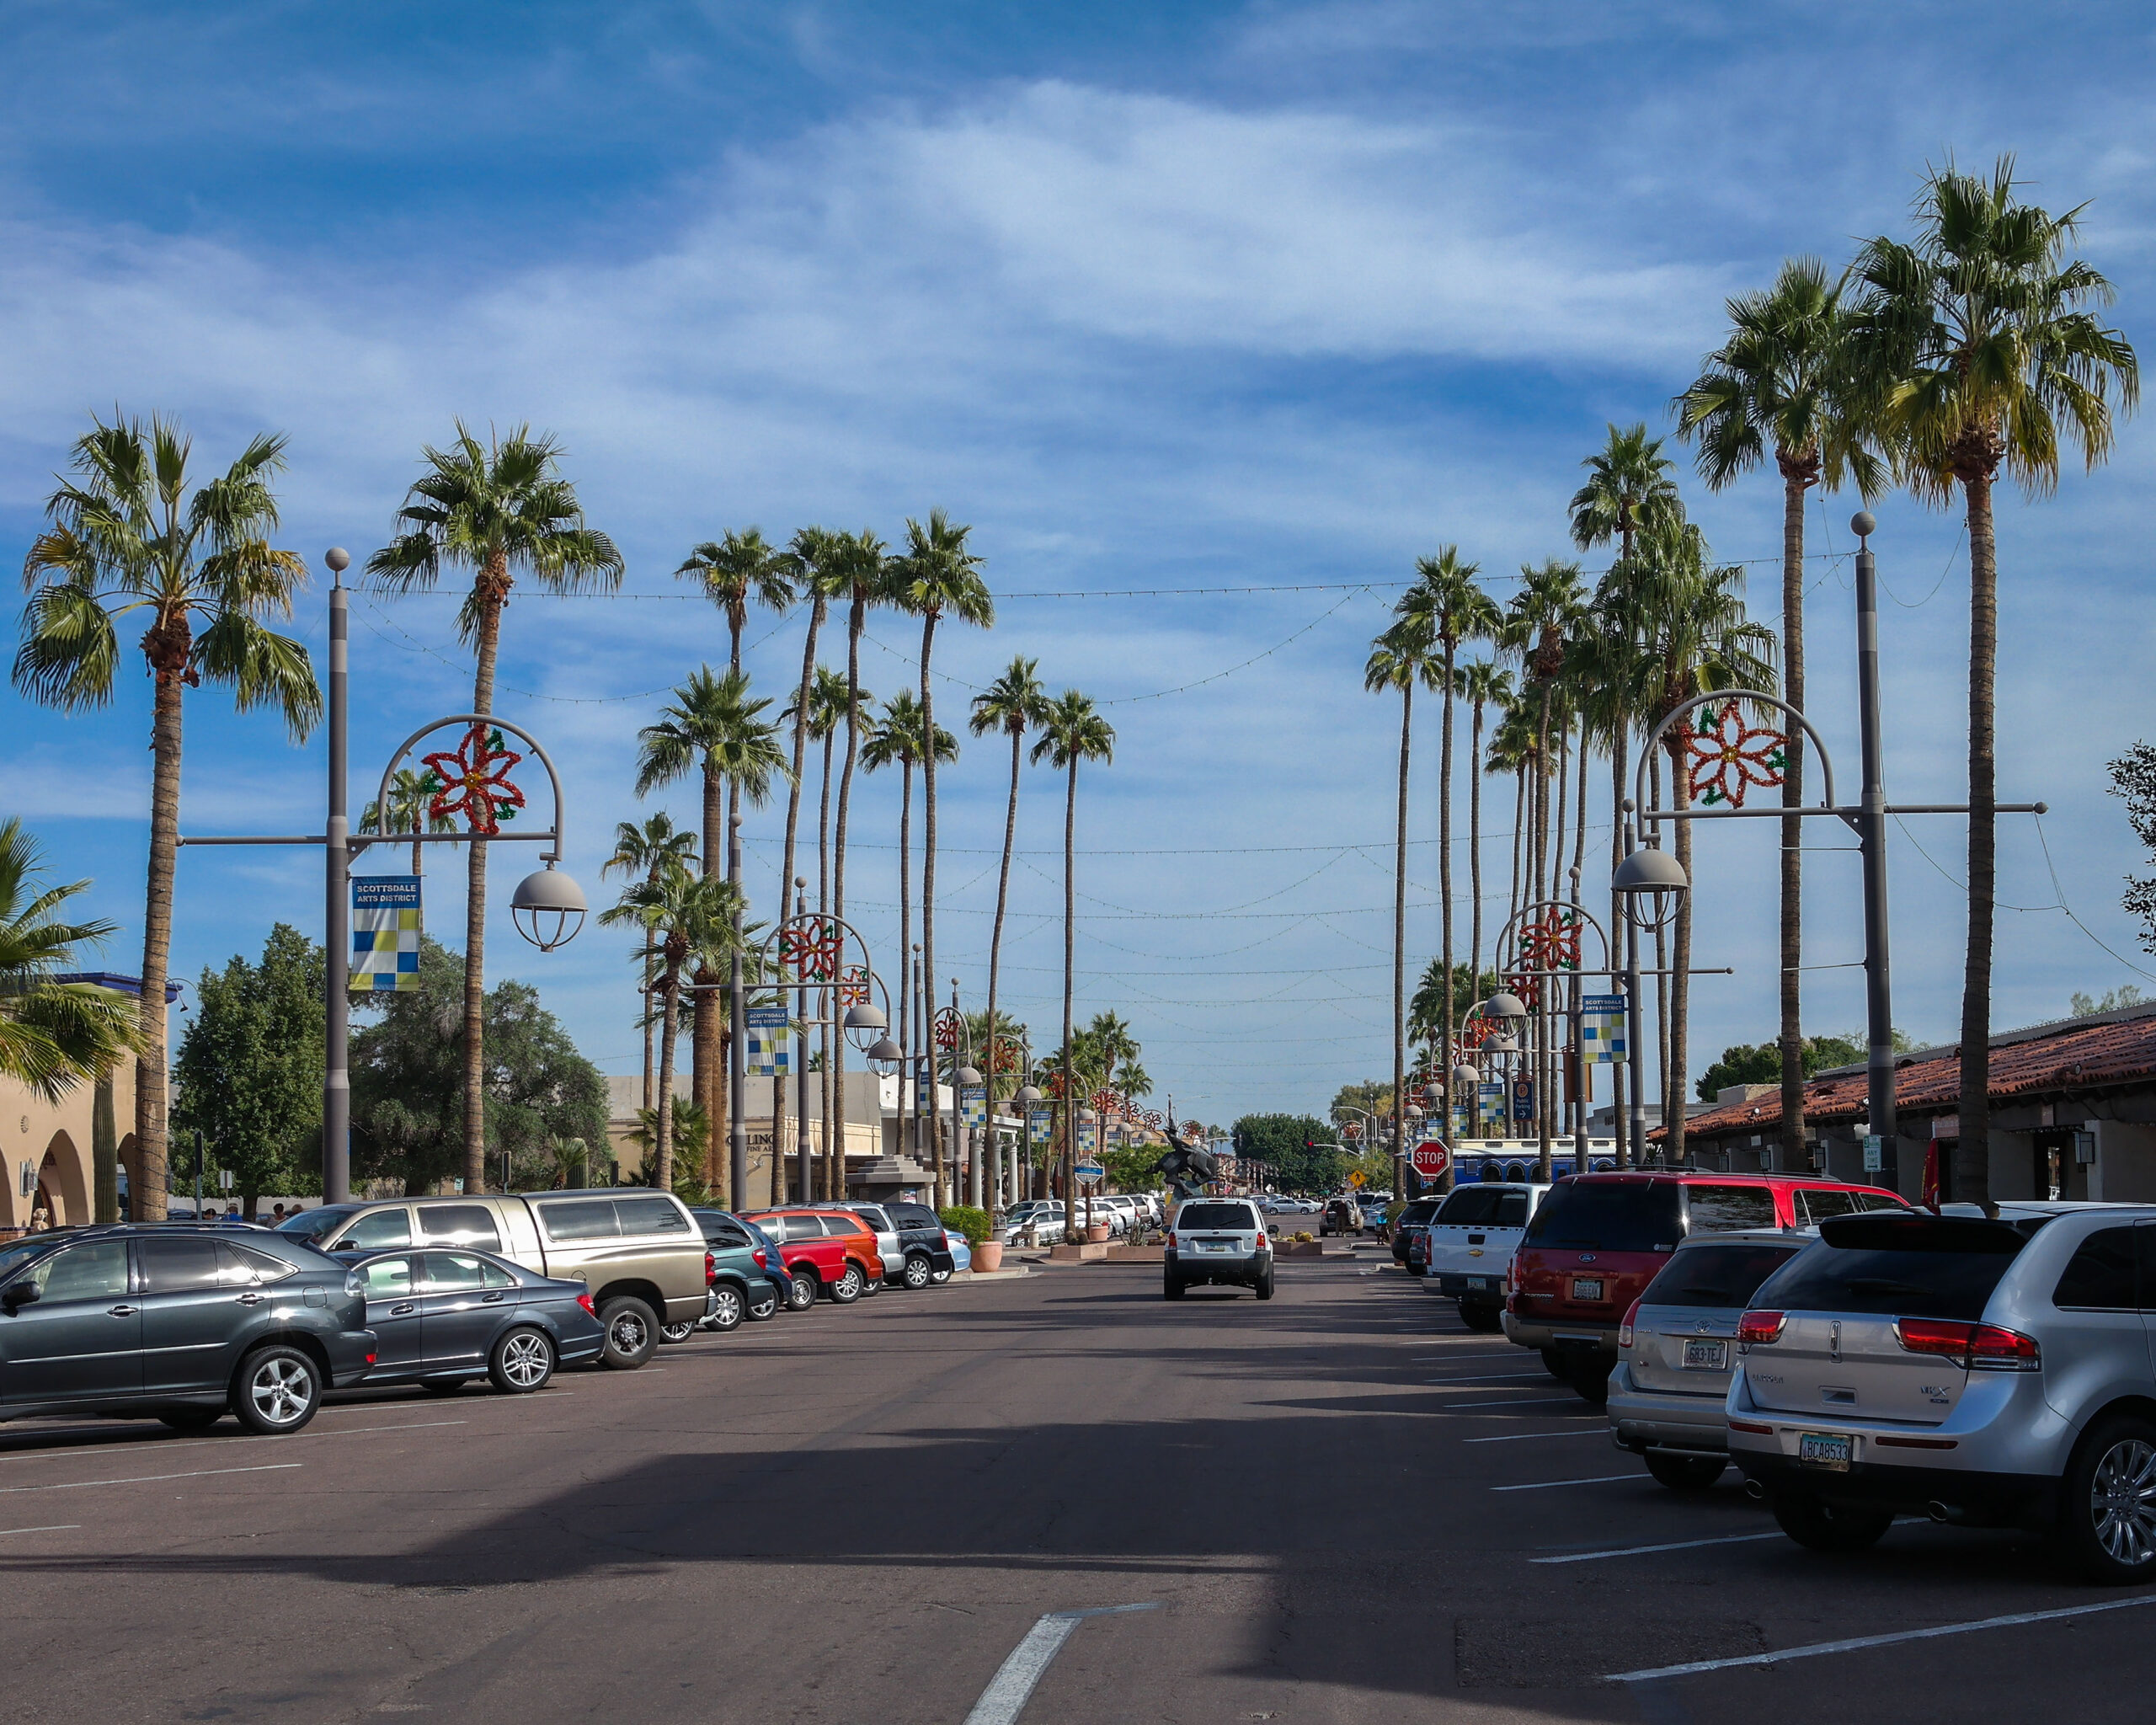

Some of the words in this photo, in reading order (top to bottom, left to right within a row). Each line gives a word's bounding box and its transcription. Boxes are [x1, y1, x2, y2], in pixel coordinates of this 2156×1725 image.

[357, 884, 416, 893] SCOTTSDALE
[1416, 1152, 1444, 1164] STOP
[1752, 1374, 1784, 1384] LINCOLN
[1806, 1441, 1848, 1461] BCA8533
